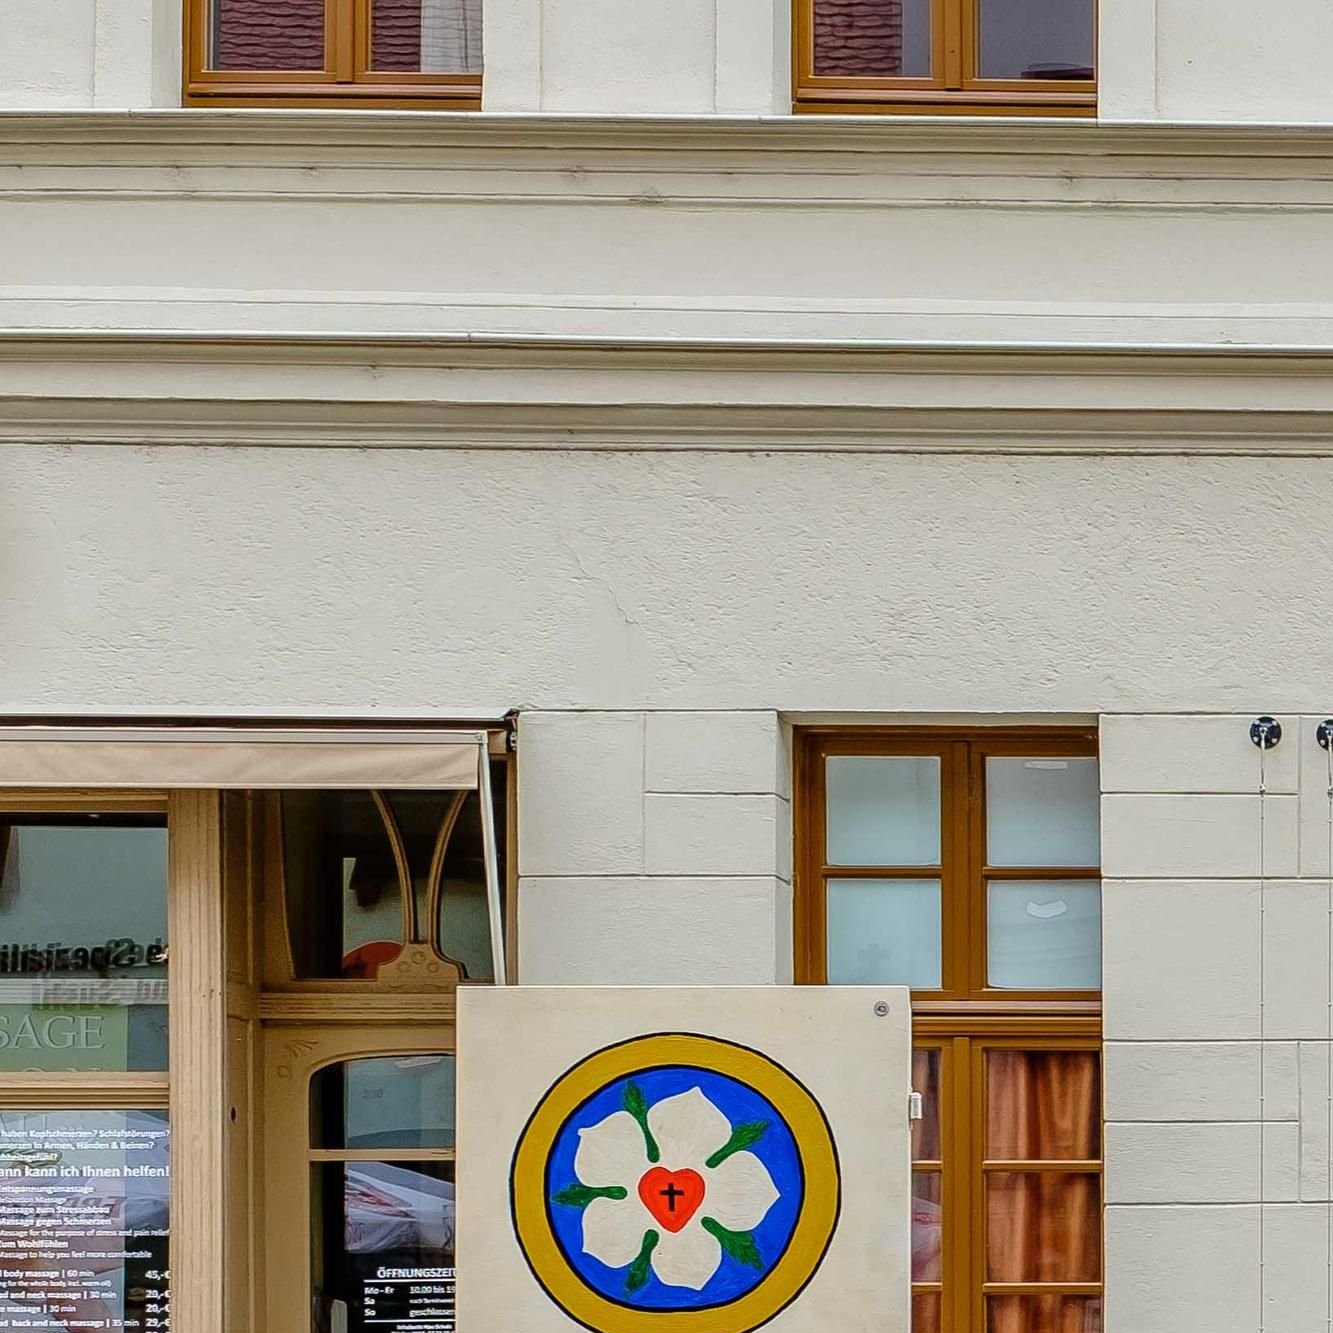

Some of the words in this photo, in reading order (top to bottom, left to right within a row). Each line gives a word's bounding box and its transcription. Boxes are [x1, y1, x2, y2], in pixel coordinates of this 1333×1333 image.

[25, 1165, 57, 1177] kann
[60, 1166, 79, 1177] ich
[82, 1166, 121, 1177] Ihnen
[123, 1166, 169, 1177] helfen!
